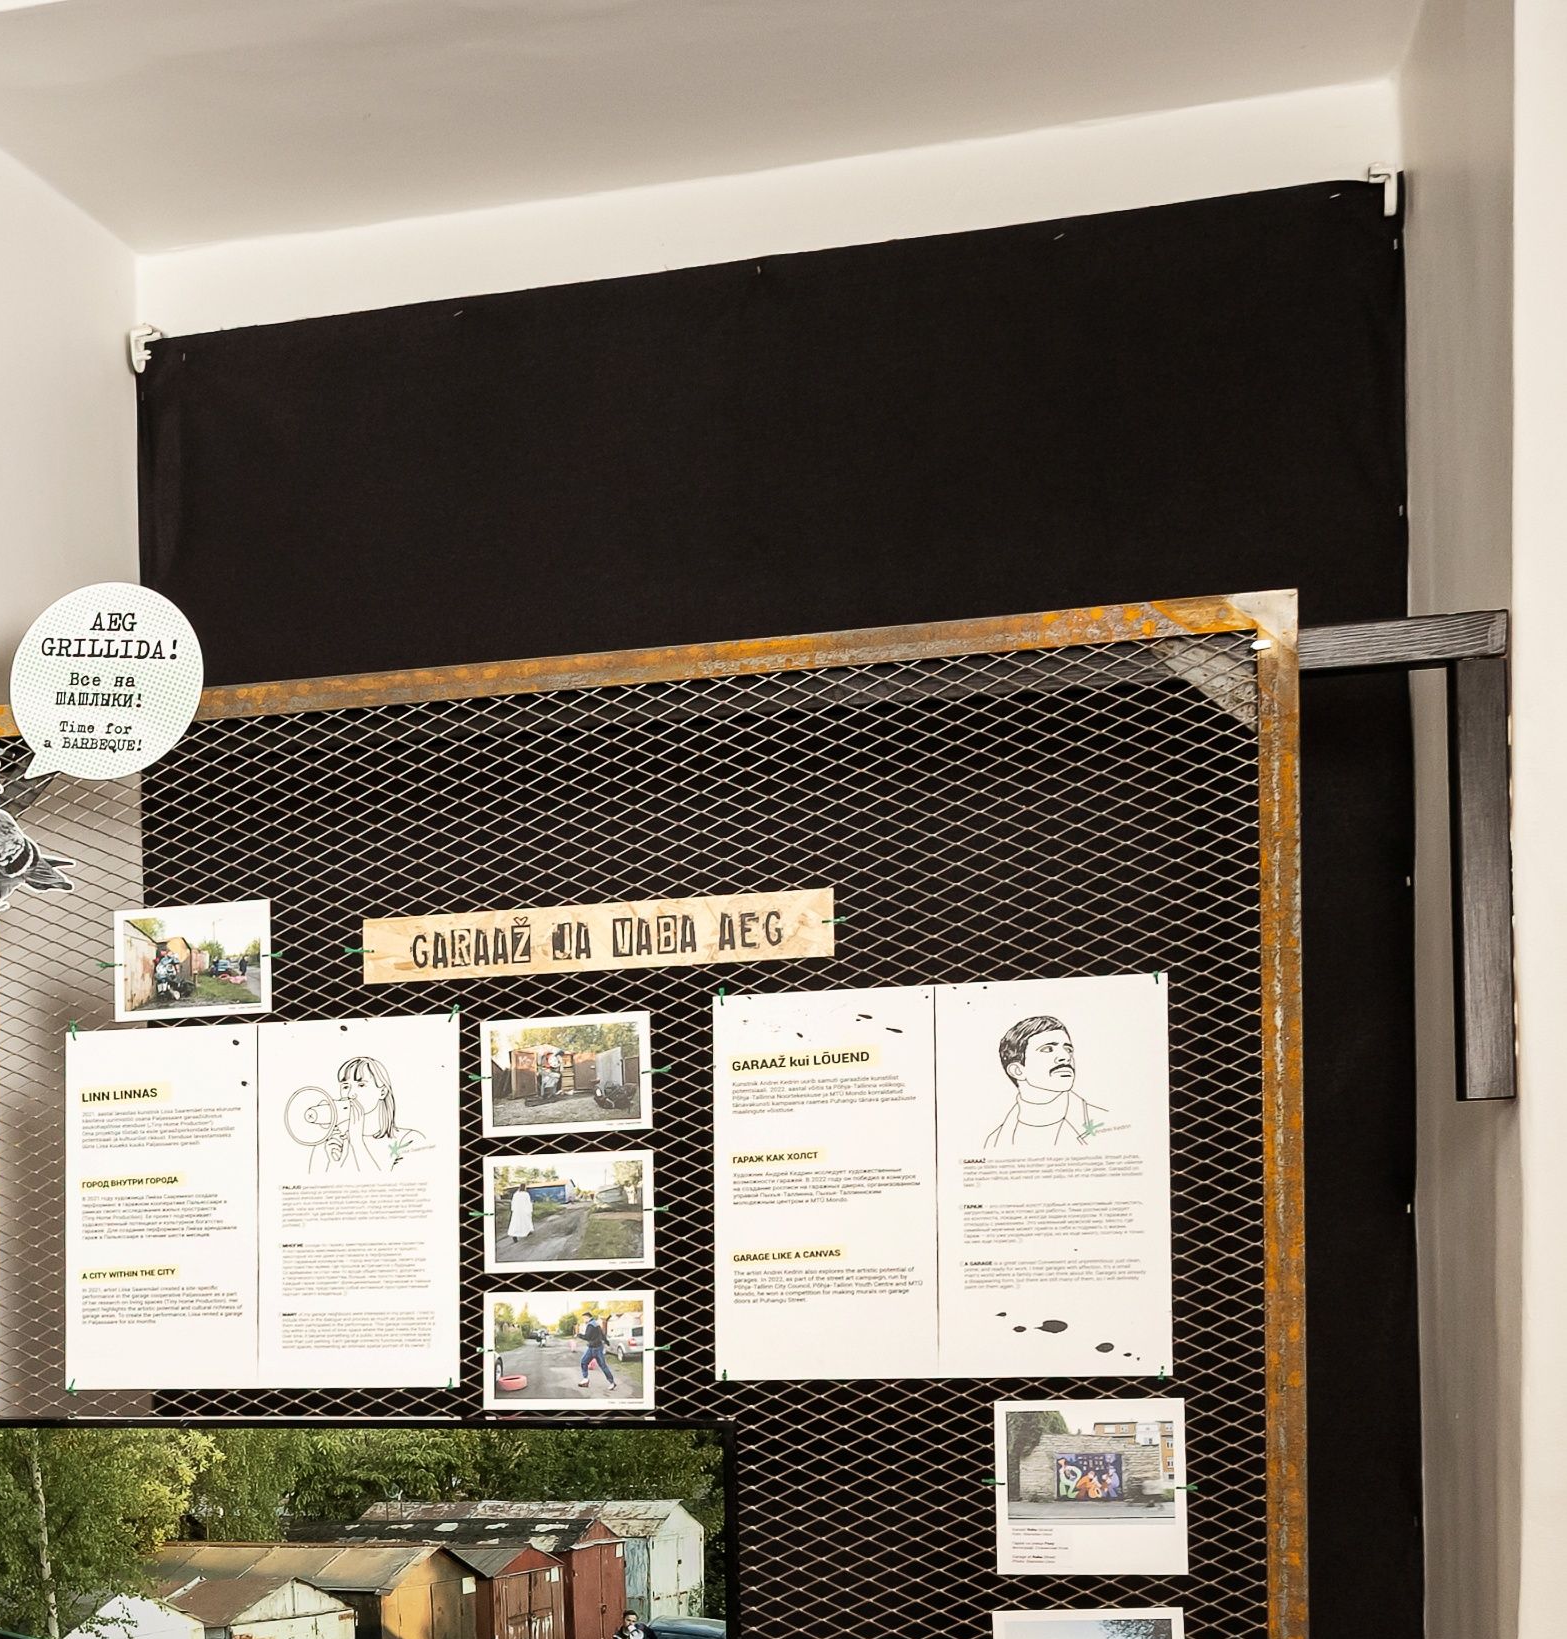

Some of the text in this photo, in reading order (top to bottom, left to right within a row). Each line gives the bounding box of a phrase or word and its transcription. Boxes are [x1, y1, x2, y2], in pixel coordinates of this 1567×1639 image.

[90, 613, 136, 632] AEG
[42, 638, 178, 660] GRILLIDA!
[69, 673, 135, 687] Все на
[55, 692, 143, 709] ШАШЛЫКИ!
[59, 721, 132, 734] Time for
[43, 737, 143, 752] a BARBEQUE!
[411, 910, 783, 969] GARAAŽ JA VABA AEG
[732, 1051, 870, 1072] GARAAŽ kui LÕUEND
[82, 1088, 157, 1103] LINN LINNAS
[732, 1152, 818, 1164] ГАРАЖ КАК ХОЛСТ
[82, 1176, 179, 1189] ГОРОД ВНУТРИ ГОРОДА
[733, 1249, 841, 1262] GARAGE LIKE A CANVAS
[89, 1271, 107, 1280] CITY
[109, 1270, 138, 1278] WITHIN
[157, 1268, 175, 1276] CITY
